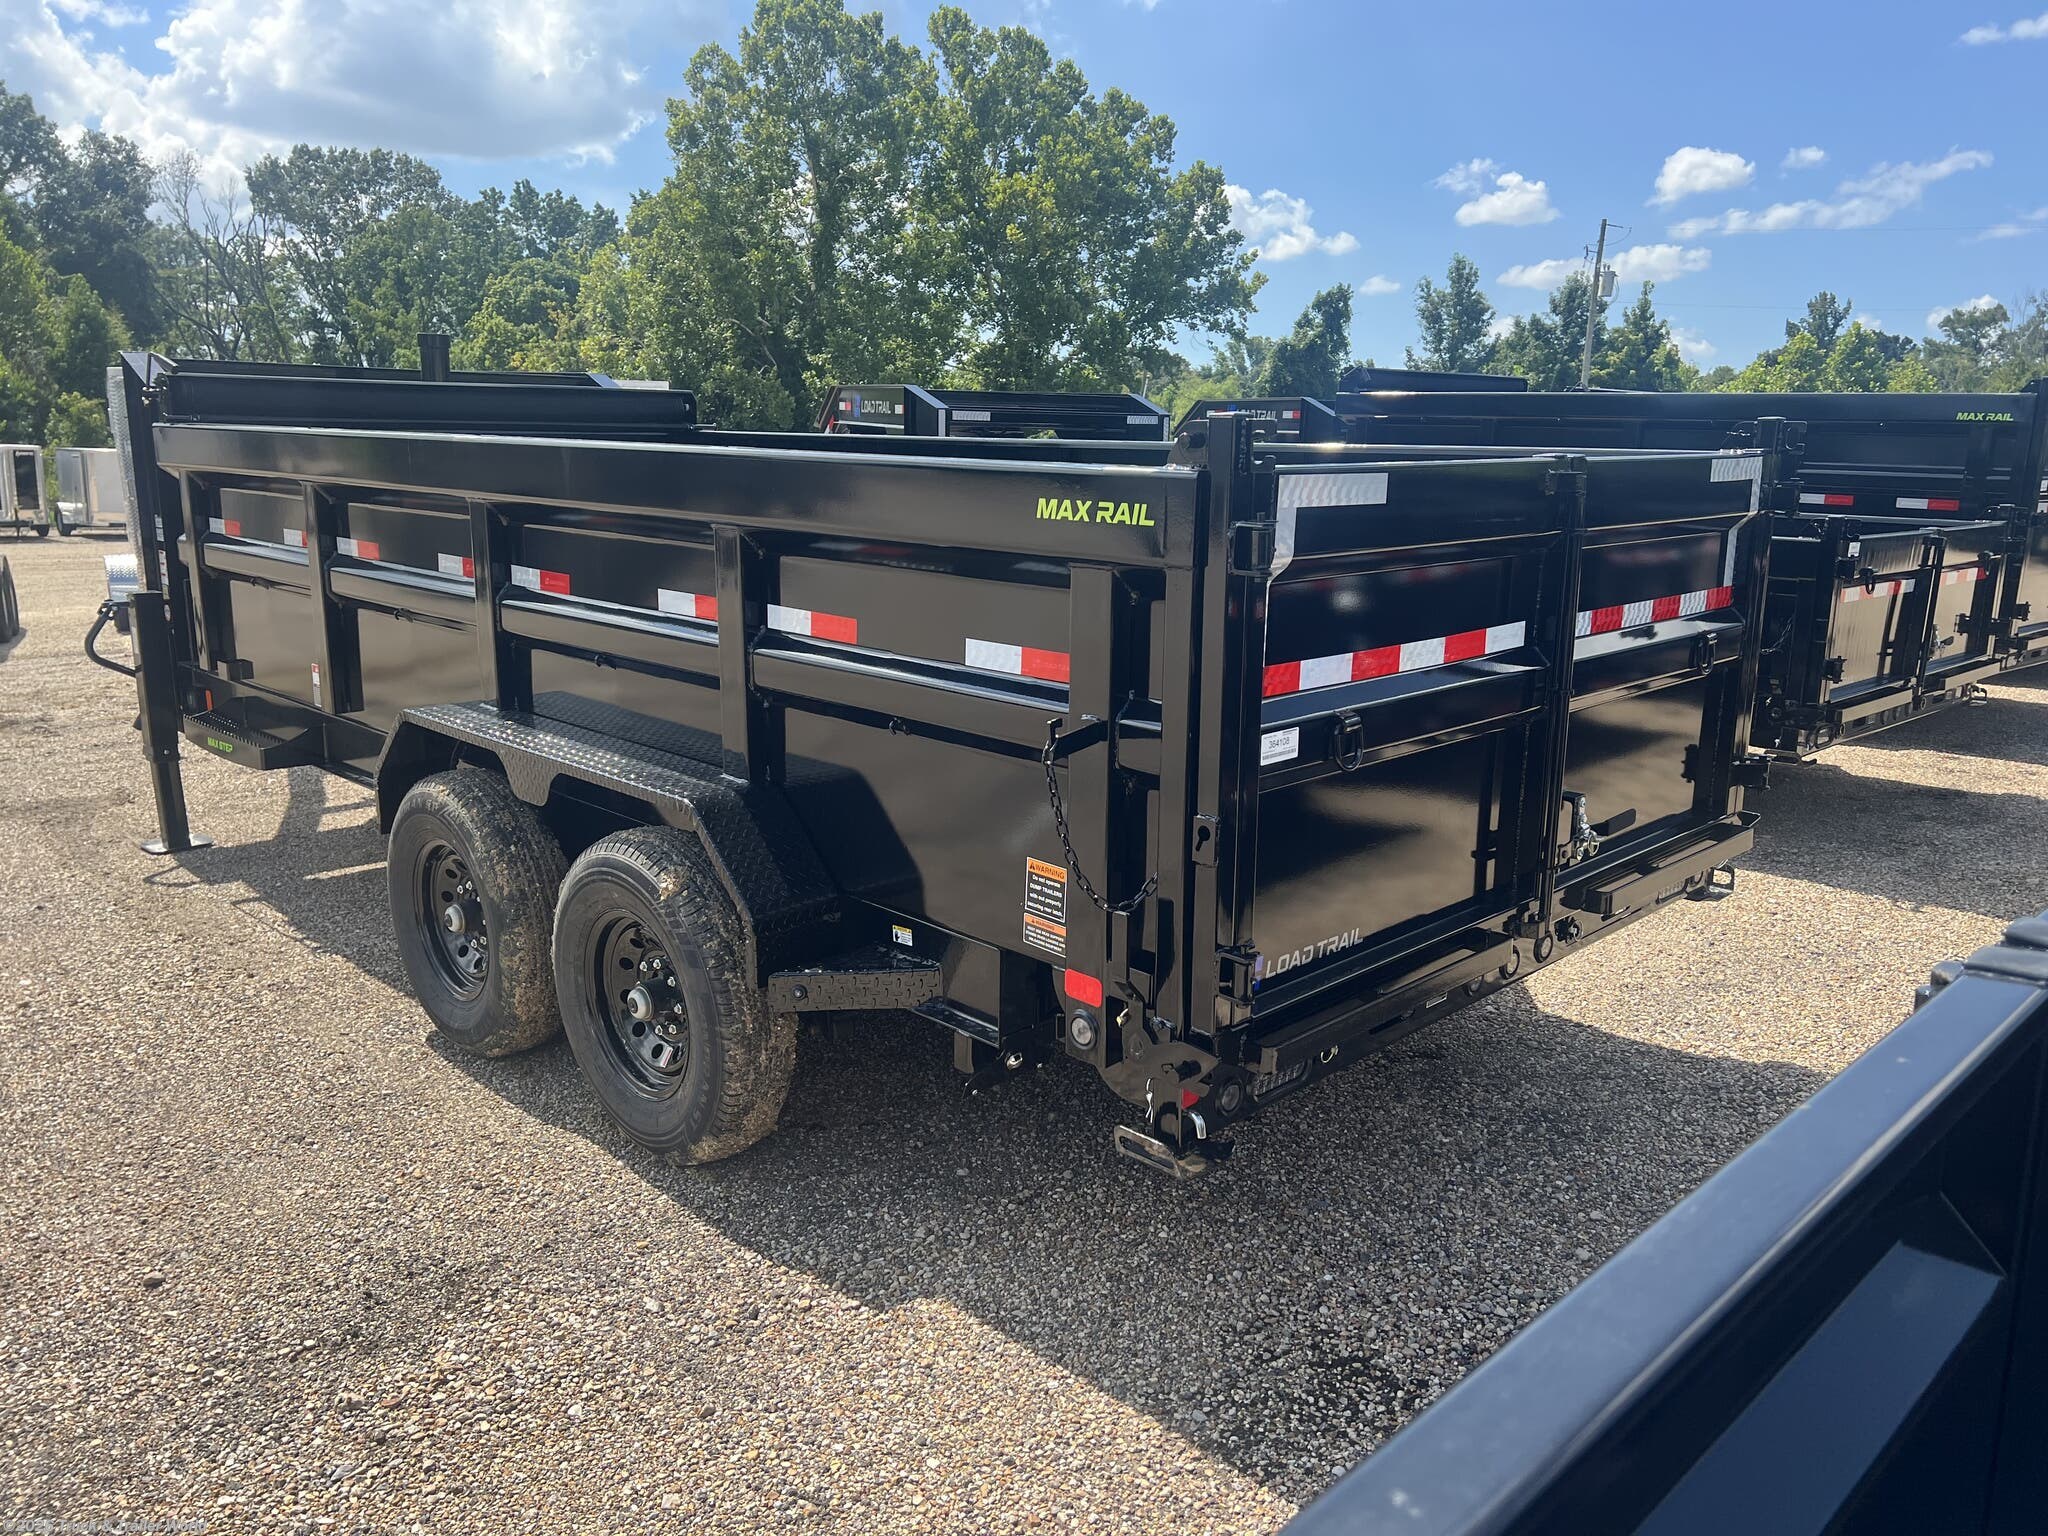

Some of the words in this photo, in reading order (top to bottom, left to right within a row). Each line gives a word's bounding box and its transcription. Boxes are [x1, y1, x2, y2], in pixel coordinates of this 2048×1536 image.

[861, 400, 876, 413] LOAD
[875, 400, 891, 414] TRAIL
[1956, 412, 1985, 421] MAX
[1986, 413, 2014, 422] RAIL
[1036, 498, 1092, 522] MAX
[1096, 501, 1155, 526] RAIL
[207, 736, 218, 749] MAX
[219, 740, 233, 752] STEP
[1036, 866, 1065, 880] WARNING
[1265, 944, 1314, 979] LOAD
[1317, 927, 1363, 959] TRAIL
